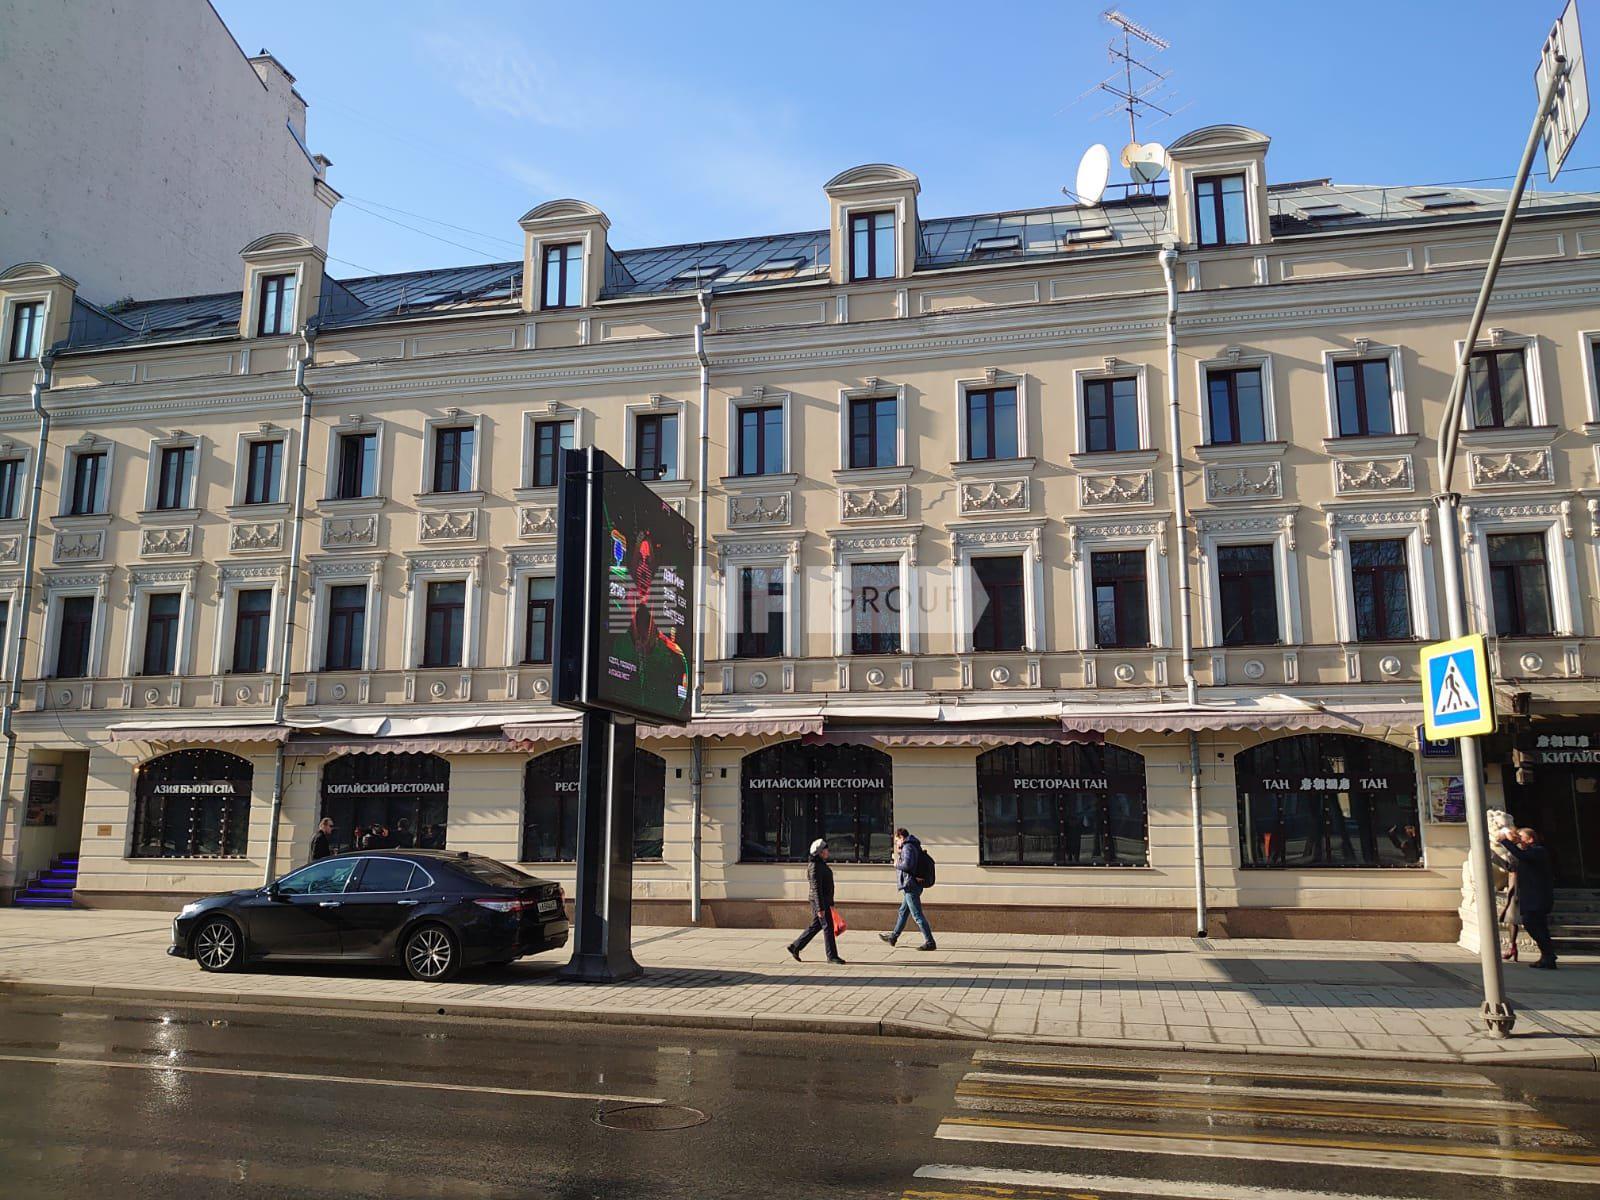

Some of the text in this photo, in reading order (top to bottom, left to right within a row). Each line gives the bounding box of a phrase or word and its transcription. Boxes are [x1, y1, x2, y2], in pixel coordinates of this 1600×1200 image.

[327, 782, 445, 794] КИТАЙСКИЙ РЕСТОРАН
[747, 776, 885, 789] КИТАЙСКИЙ РЕСТОРАН
[1013, 778, 1108, 789] РЕСТОРАН ТАН
[1262, 779, 1290, 790] ТАН
[1360, 778, 1388, 789] ТАН
[153, 784, 236, 794] АЗИЯ БЬЮТИ СПА
